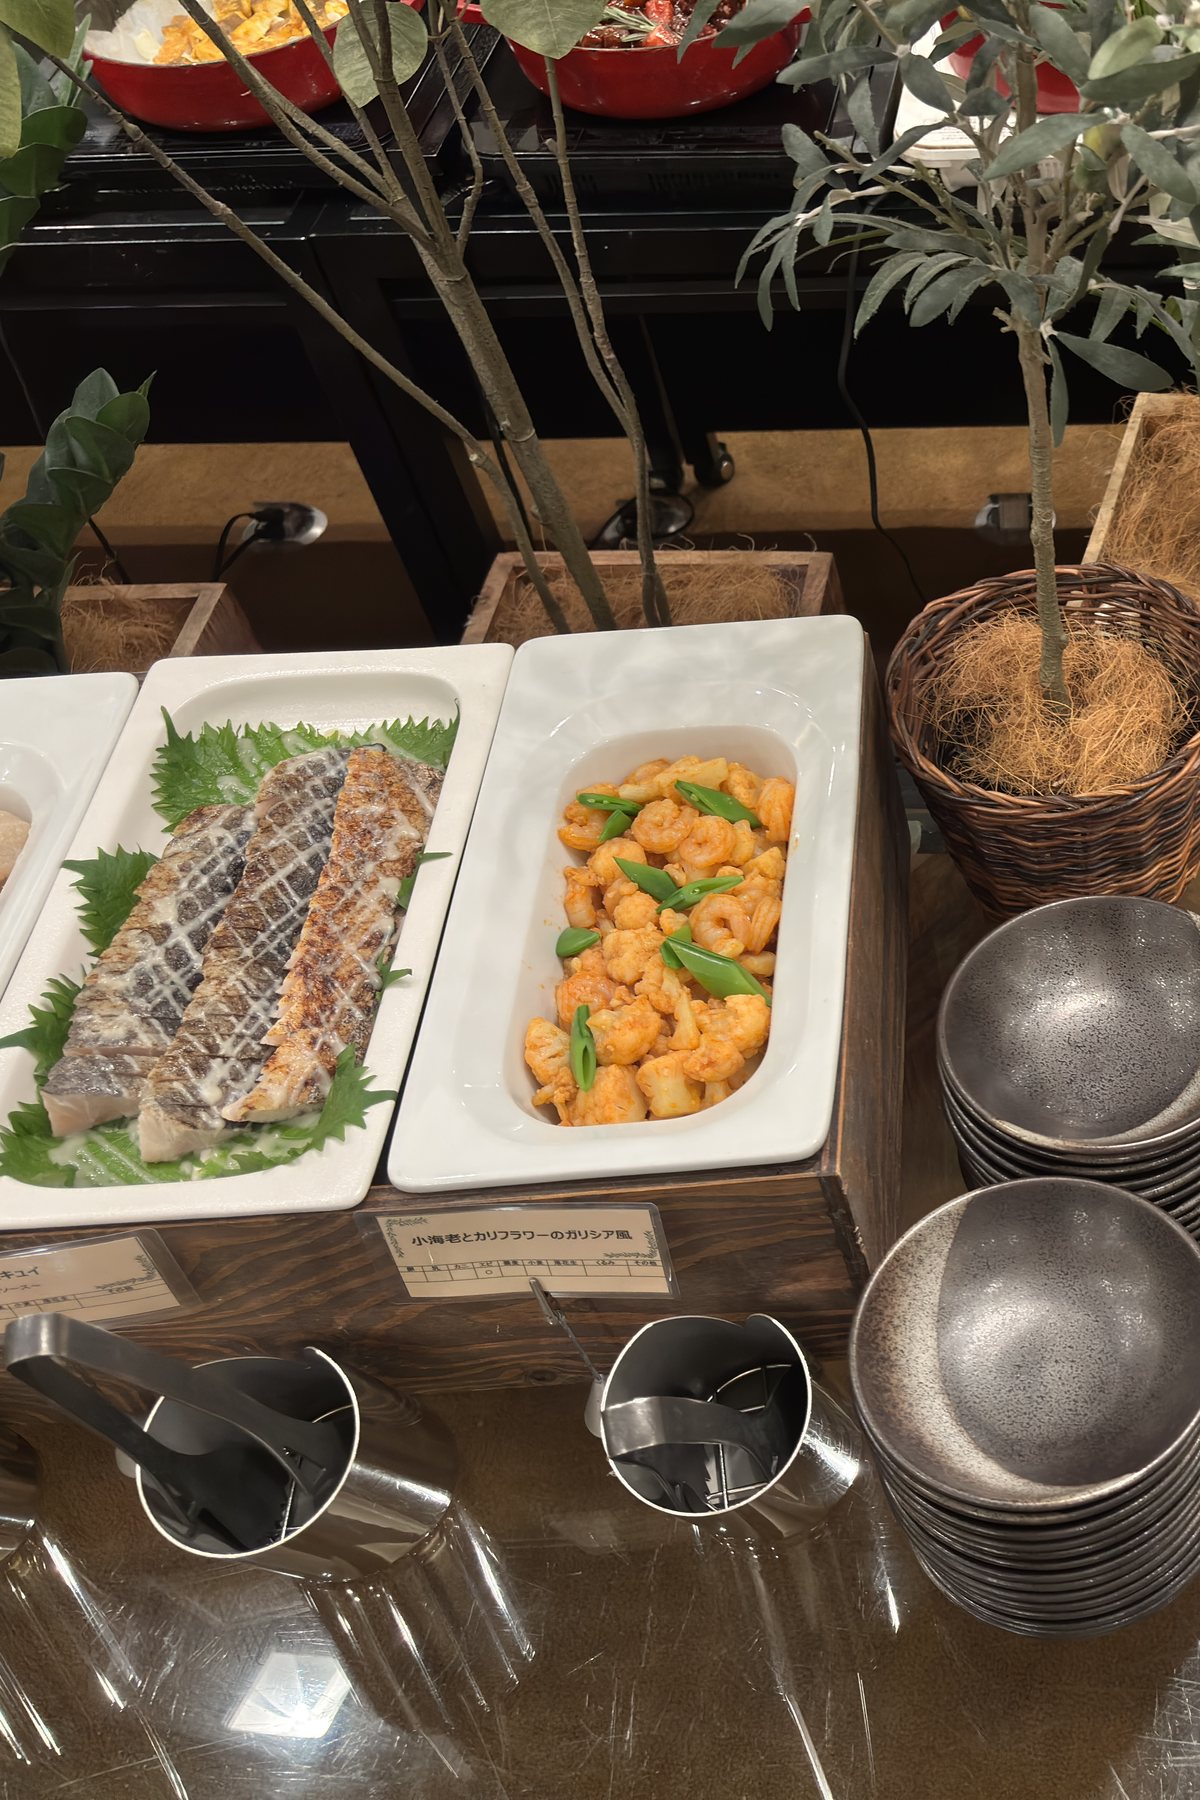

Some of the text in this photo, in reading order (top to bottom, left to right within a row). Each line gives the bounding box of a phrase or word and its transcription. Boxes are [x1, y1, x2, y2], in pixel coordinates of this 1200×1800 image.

[412, 1230, 632, 1246] 小海老とカリフラワーのガリシア風
